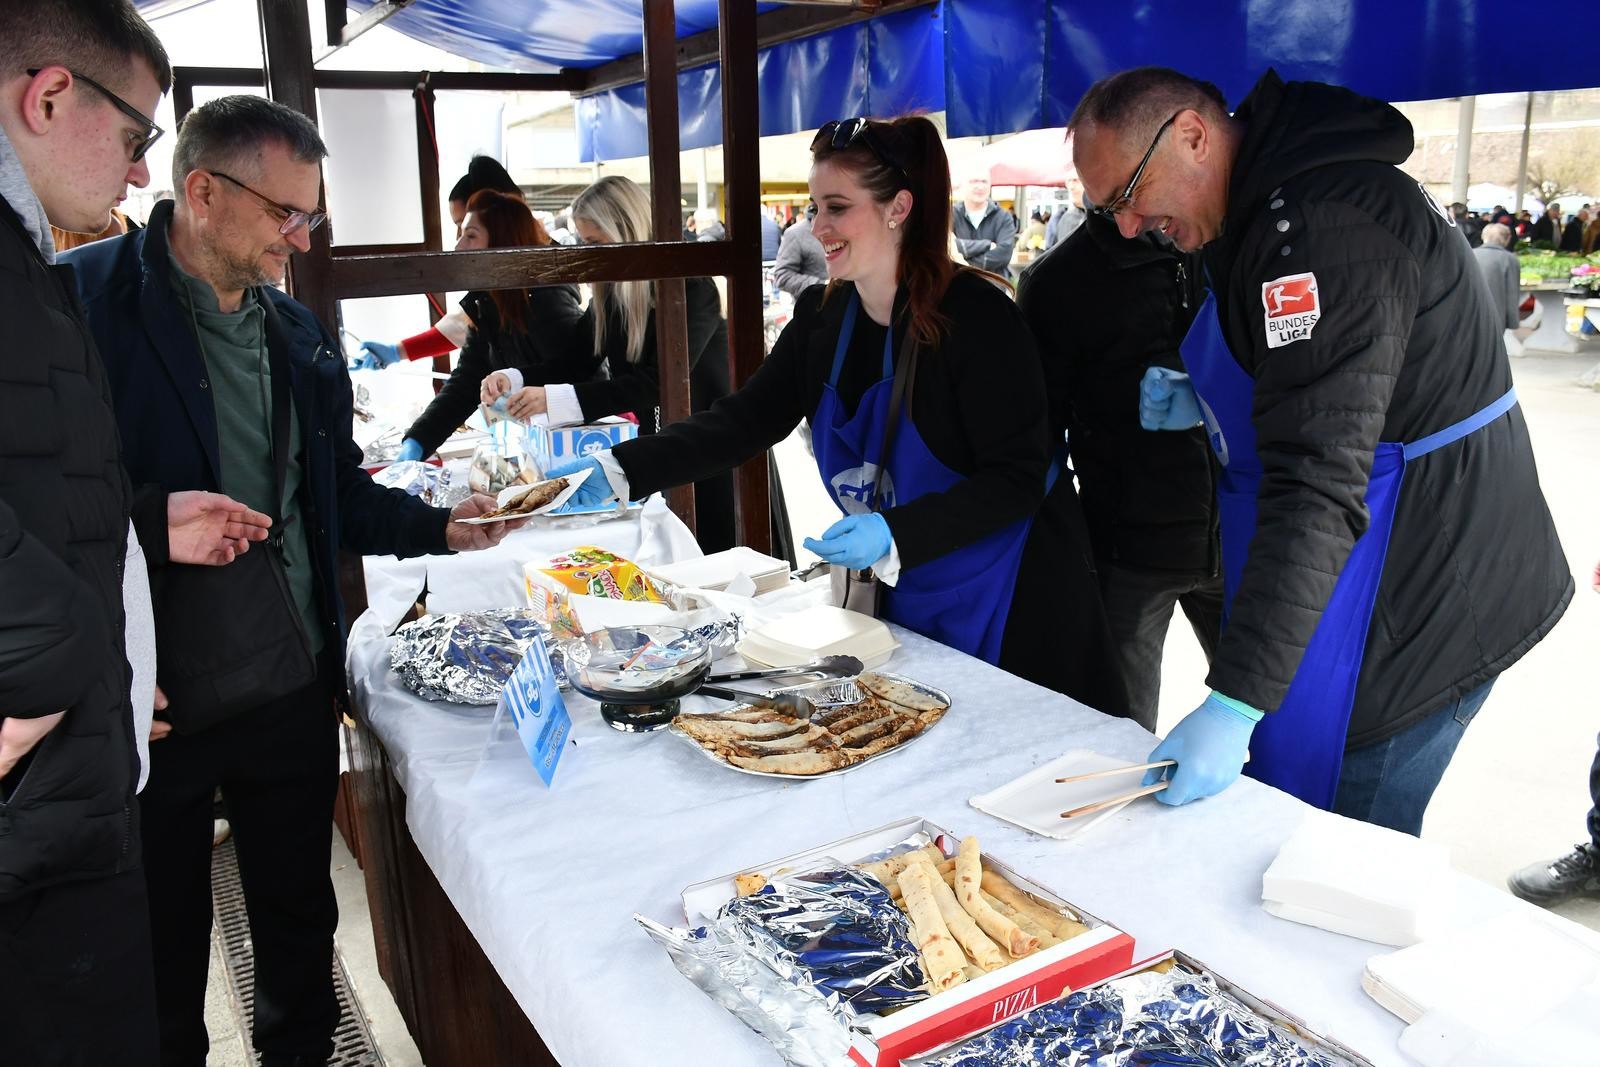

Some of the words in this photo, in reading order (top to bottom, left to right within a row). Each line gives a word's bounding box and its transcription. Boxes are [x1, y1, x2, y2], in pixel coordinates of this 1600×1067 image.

[1269, 314, 1317, 332] BUNDES
[1279, 328, 1307, 342] LIGA
[991, 985, 1038, 1022] PIZZA
